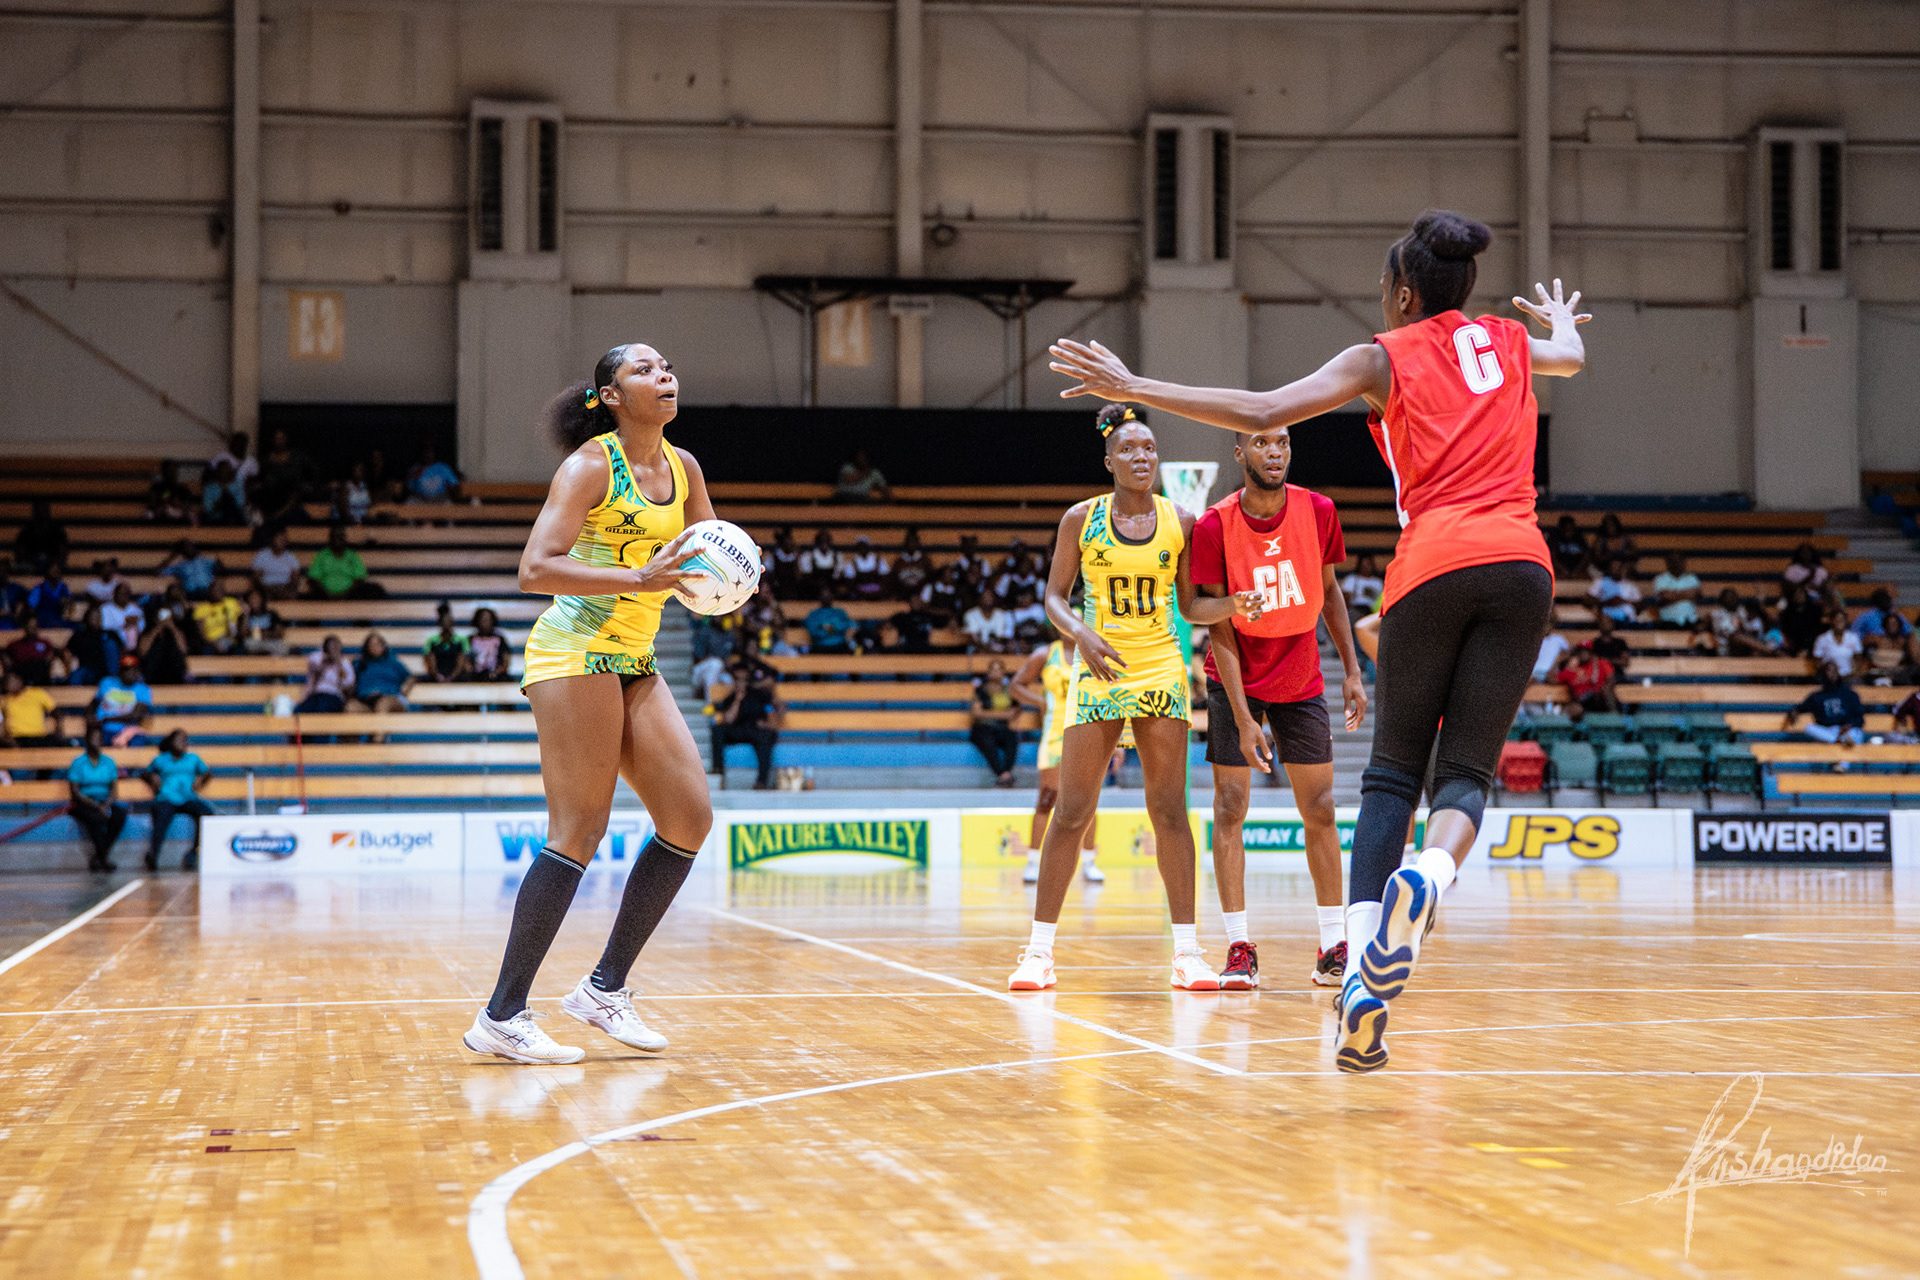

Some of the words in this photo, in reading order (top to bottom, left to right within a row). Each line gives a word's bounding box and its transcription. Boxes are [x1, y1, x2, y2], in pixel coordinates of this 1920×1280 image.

[1453, 324, 1504, 394] C
[605, 526, 648, 536] GILBERT
[702, 531, 756, 578] GILBERT
[1106, 574, 1158, 618] GD
[1253, 559, 1306, 613] GA
[361, 830, 433, 854] Budget
[737, 823, 833, 863] NATURE
[834, 821, 922, 859] VALLEY
[1489, 815, 1621, 860] JPS
[1700, 821, 1886, 853] POWERADE
